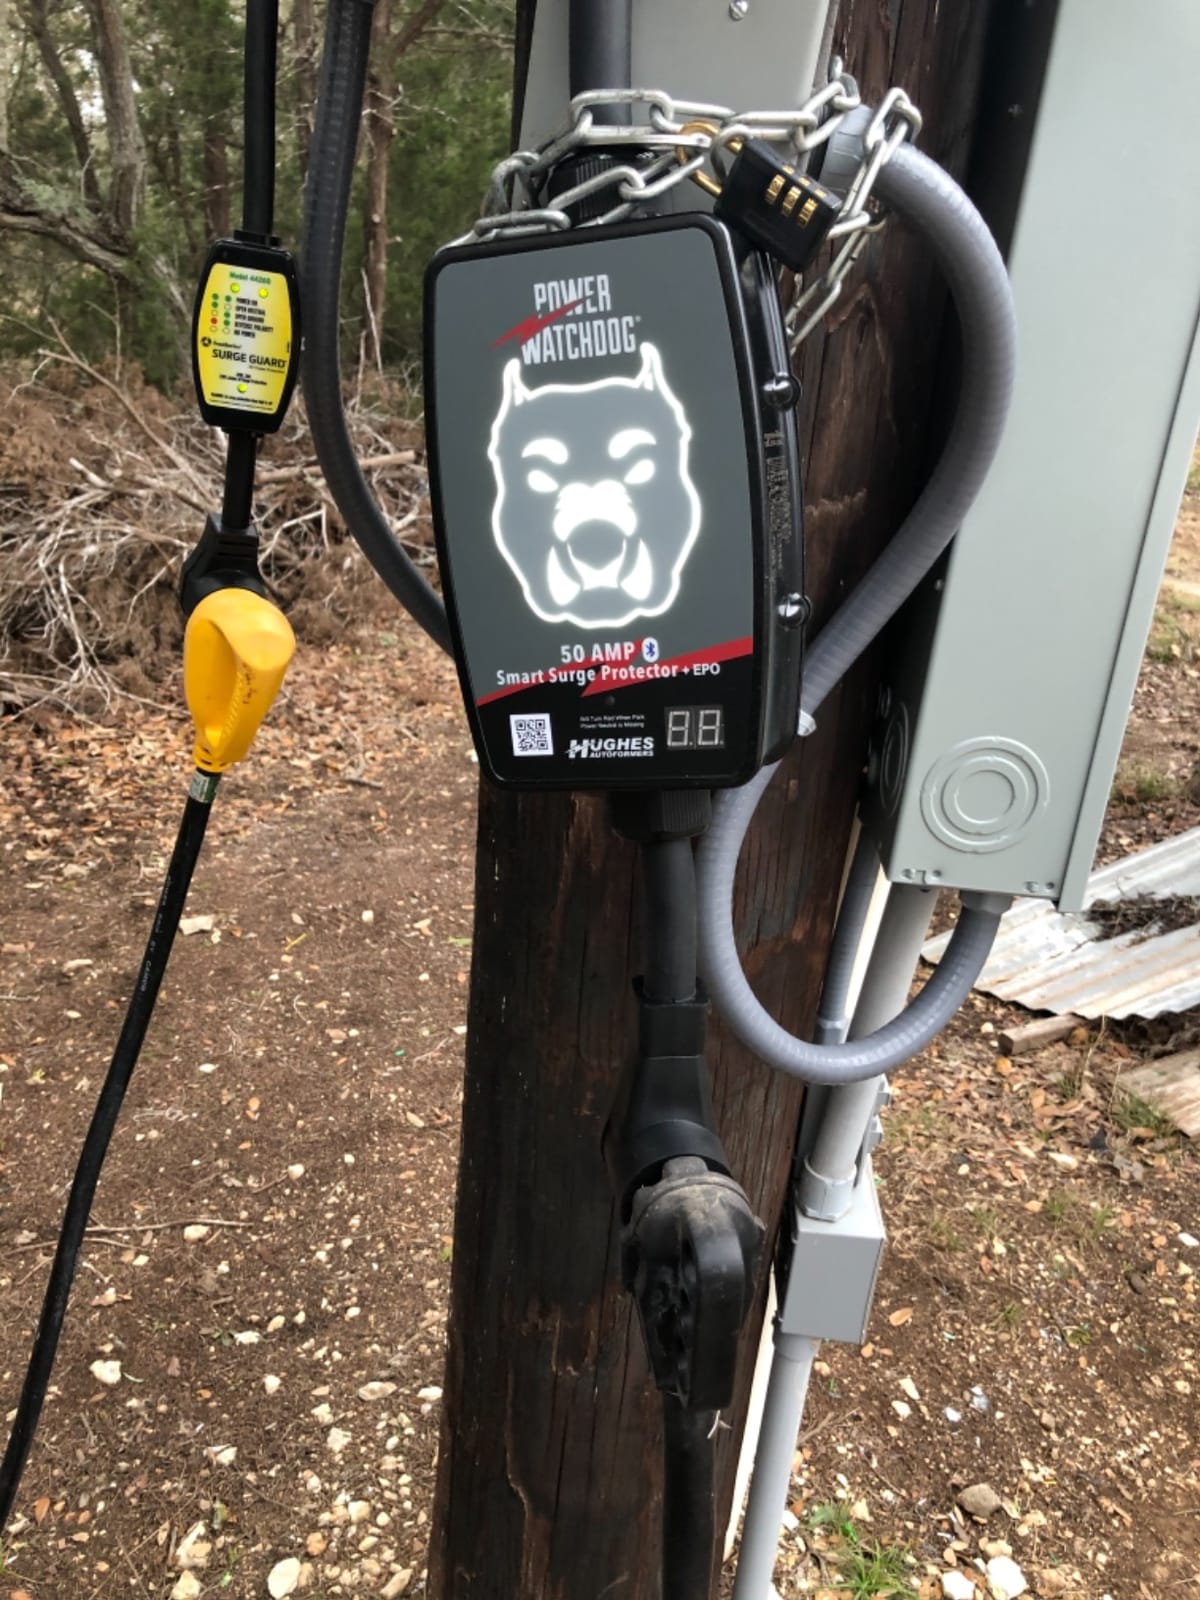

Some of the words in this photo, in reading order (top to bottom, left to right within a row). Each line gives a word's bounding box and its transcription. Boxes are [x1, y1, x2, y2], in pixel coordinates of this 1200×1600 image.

[533, 274, 611, 317] POWER
[521, 316, 636, 365] WATCHDOG
[212, 348, 247, 363] SURGE
[249, 354, 287, 368] GUARD
[561, 645, 585, 664] 50
[592, 641, 635, 663] AMP
[496, 668, 545, 686] Smart
[550, 667, 596, 687] Surge
[601, 662, 678, 681] Protector
[693, 662, 721, 677] EPO
[566, 737, 654, 759] HUGHES
